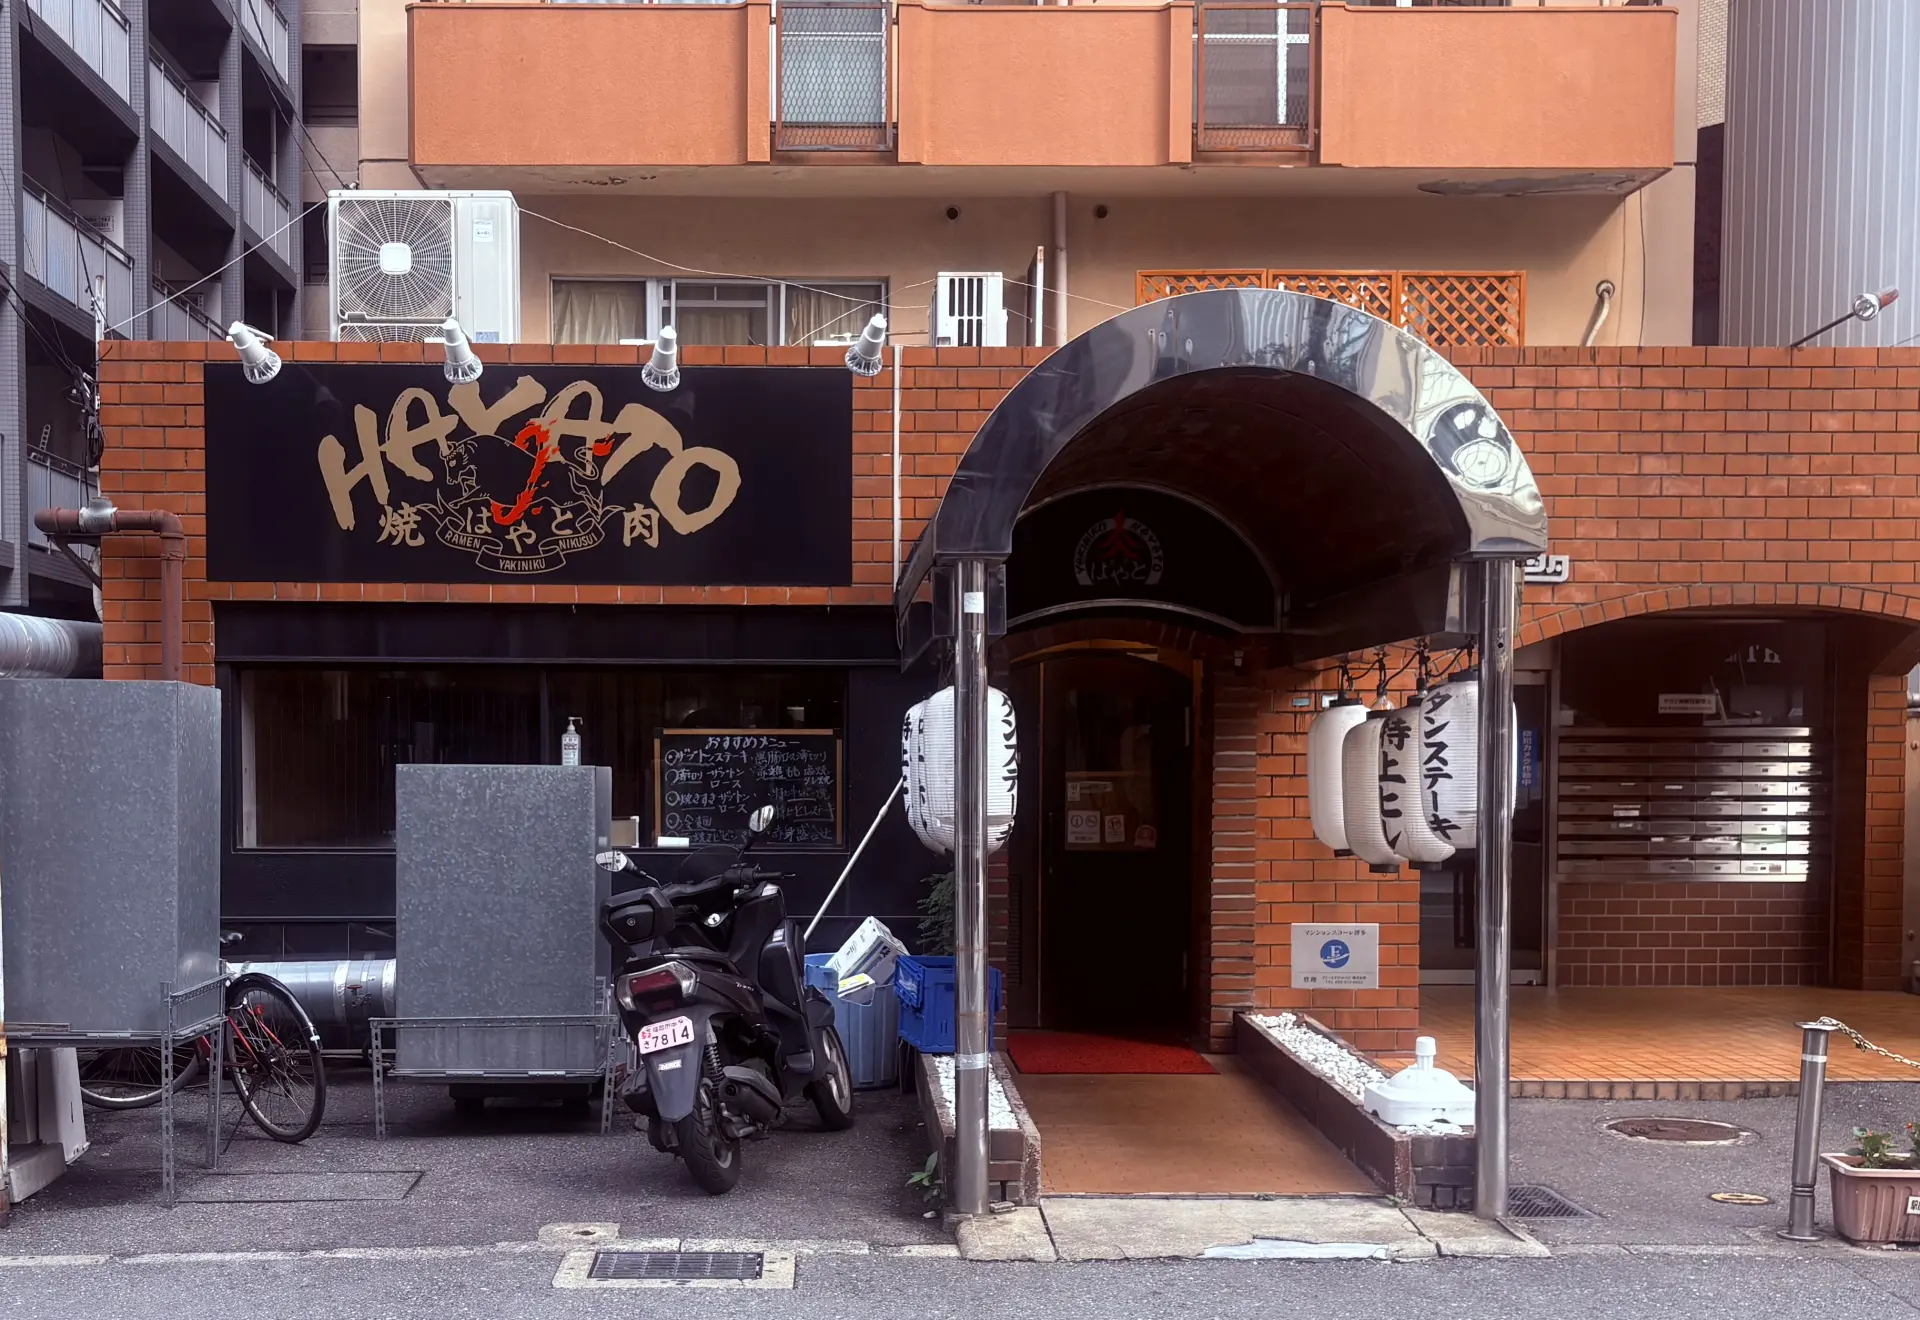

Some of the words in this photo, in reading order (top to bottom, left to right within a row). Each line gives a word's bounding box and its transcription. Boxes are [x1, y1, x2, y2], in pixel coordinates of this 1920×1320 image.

[317, 374, 742, 535] HAYATO
[376, 503, 426, 547] 焼
[465, 506, 574, 554] はやと
[622, 503, 660, 547] 肉
[444, 530, 482, 550] RAMEN
[557, 532, 599, 551] NIKUSUI
[499, 558, 546, 571] YAKINIKU
[1090, 559, 1146, 588] はやと
[705, 736, 801, 750] おすすめメニュー
[1423, 692, 1462, 841] タンステーキ
[710, 779, 742, 789] ロース
[1378, 717, 1413, 851] 特上ヒレ
[719, 804, 749, 814] ロース
[651, 1025, 690, 1048] 7814
